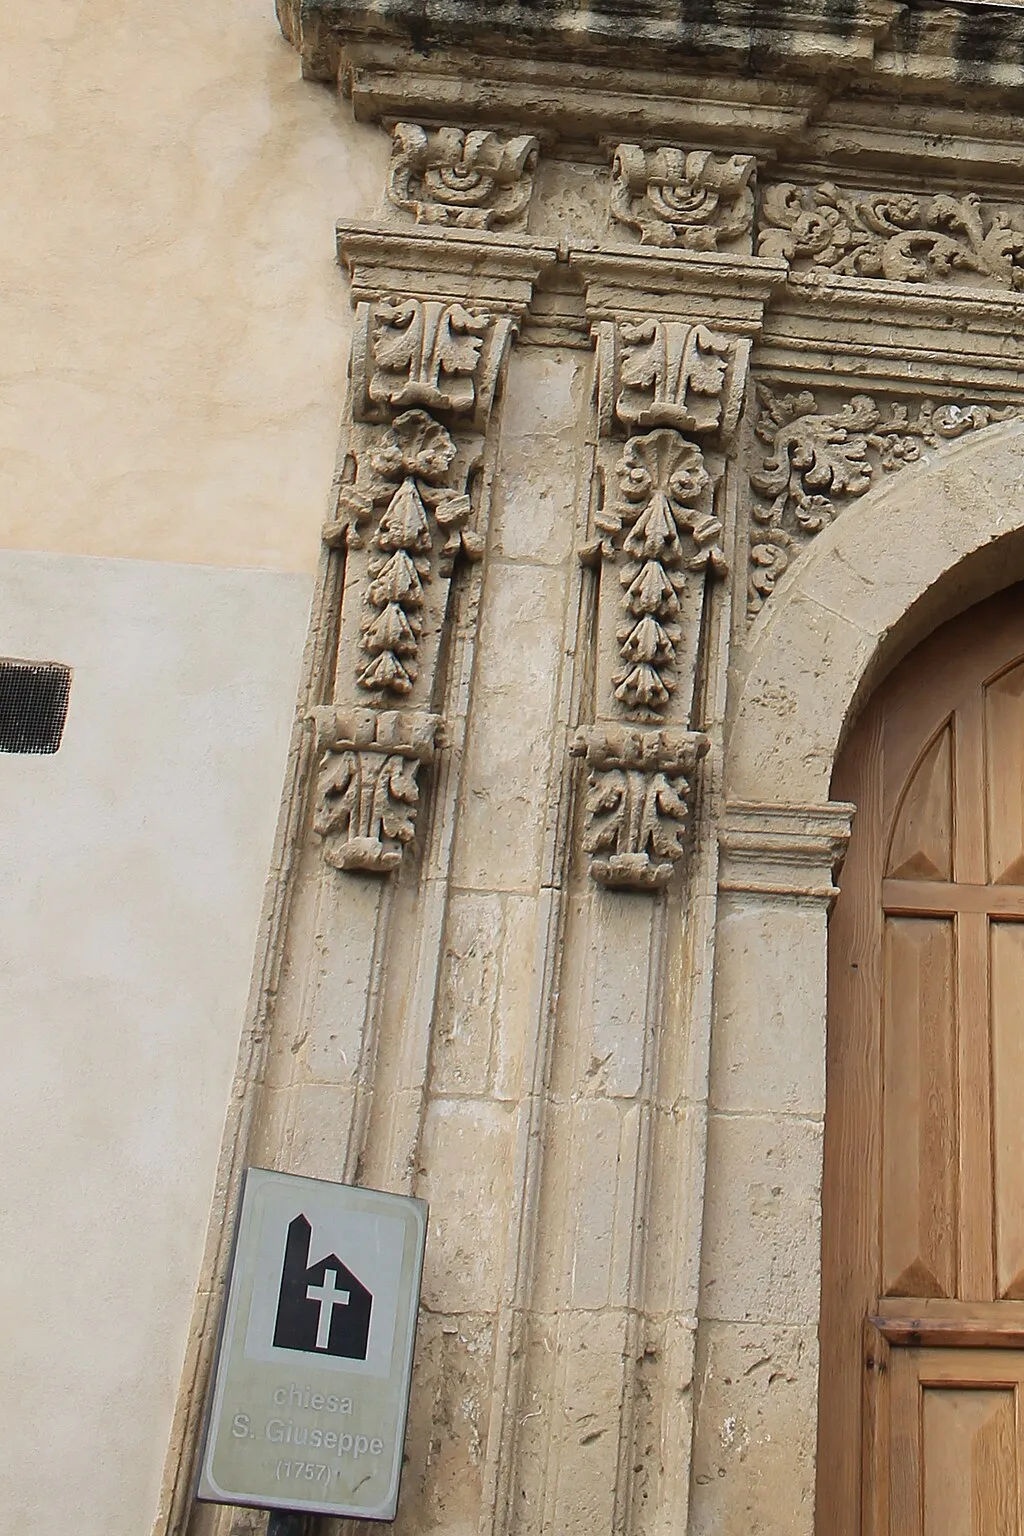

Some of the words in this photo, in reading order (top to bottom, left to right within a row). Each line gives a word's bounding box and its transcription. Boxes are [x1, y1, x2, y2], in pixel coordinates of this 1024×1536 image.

[273, 1383, 353, 1415] chiesa
[232, 1414, 255, 1439] S.
[266, 1419, 384, 1458] Giuseppe
[276, 1461, 331, 1487] (1757)
